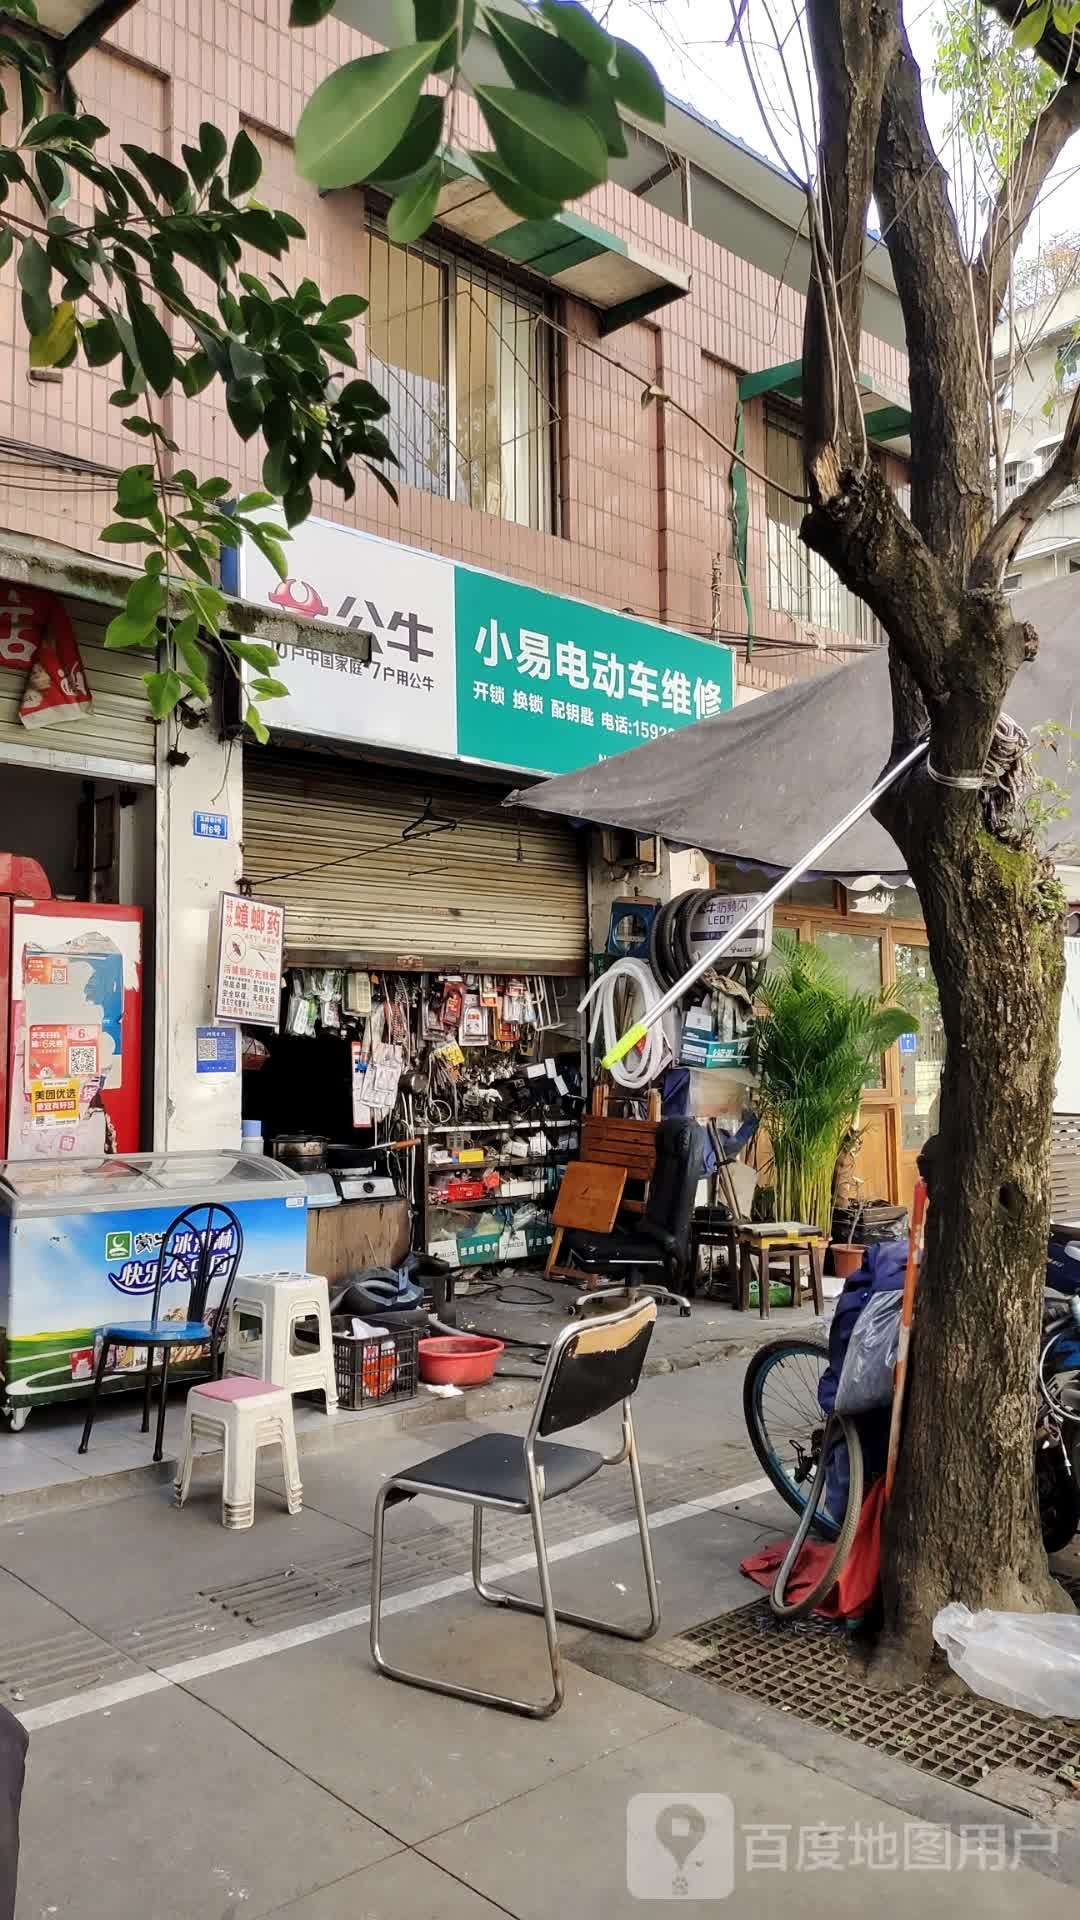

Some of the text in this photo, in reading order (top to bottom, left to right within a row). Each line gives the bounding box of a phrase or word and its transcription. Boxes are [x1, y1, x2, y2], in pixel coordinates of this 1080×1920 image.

[336, 596, 434, 663] 公牛
[474, 618, 722, 719] 小易电动车维修
[473, 680, 505, 706] 开锁
[513, 689, 544, 714] 换锁
[551, 699, 595, 727] 配钥匙
[234, 902, 280, 937] 蟑螂药
[708, 914, 735, 926] LED灯
[35, 1088, 77, 1100] 美团优选
